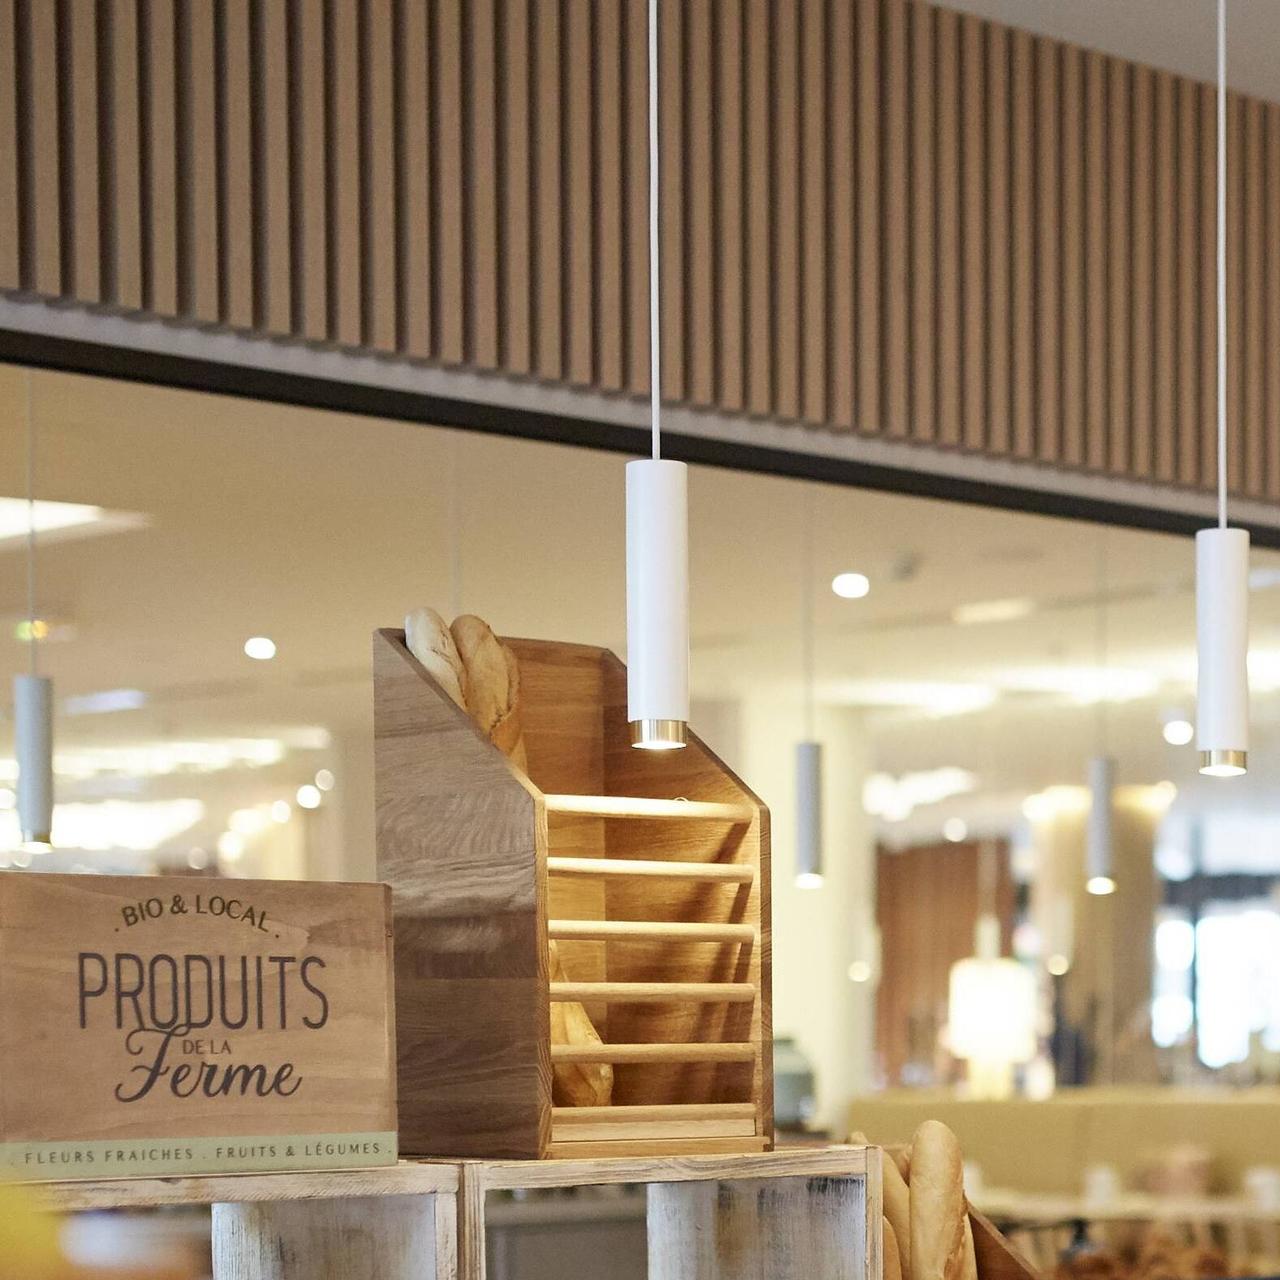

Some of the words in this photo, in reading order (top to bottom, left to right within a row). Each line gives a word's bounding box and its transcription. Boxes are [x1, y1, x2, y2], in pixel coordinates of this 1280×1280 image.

[121, 898, 163, 927] BIO
[169, 893, 189, 915] &
[196, 894, 269, 933] LOCAL
[78, 952, 330, 1031] PRODUITS
[114, 1023, 303, 1103] Ferme
[182, 1039, 204, 1055] DE
[210, 1039, 232, 1056] LA
[25, 1150, 95, 1164] FLEURS
[104, 1147, 193, 1162] FRAICHES
[216, 1145, 276, 1159] FRUITS
[285, 1145, 296, 1157] &
[305, 1142, 381, 1157] LÉGUMES
